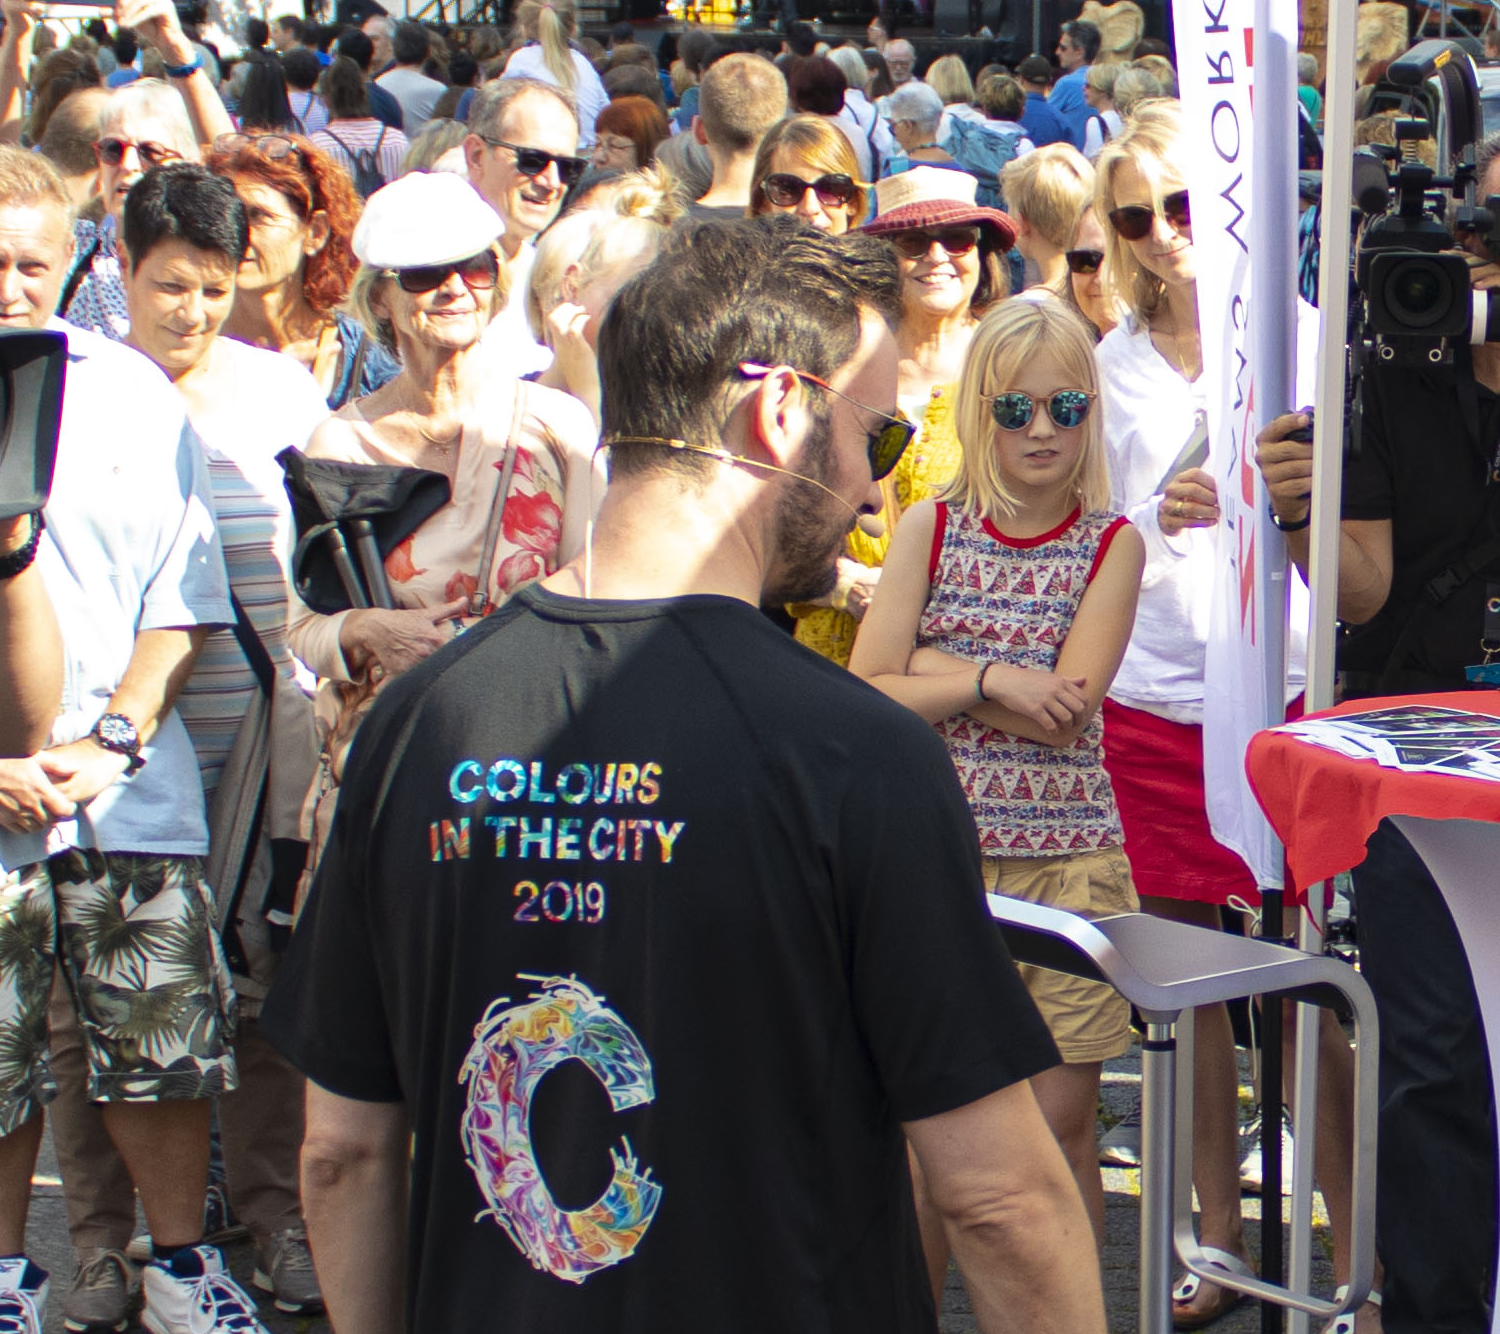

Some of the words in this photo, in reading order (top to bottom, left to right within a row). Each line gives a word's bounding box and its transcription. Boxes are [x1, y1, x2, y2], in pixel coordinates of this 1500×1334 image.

[449, 760, 663, 805] COLOURS
[429, 817, 471, 862] IN
[512, 880, 606, 924] 2019
